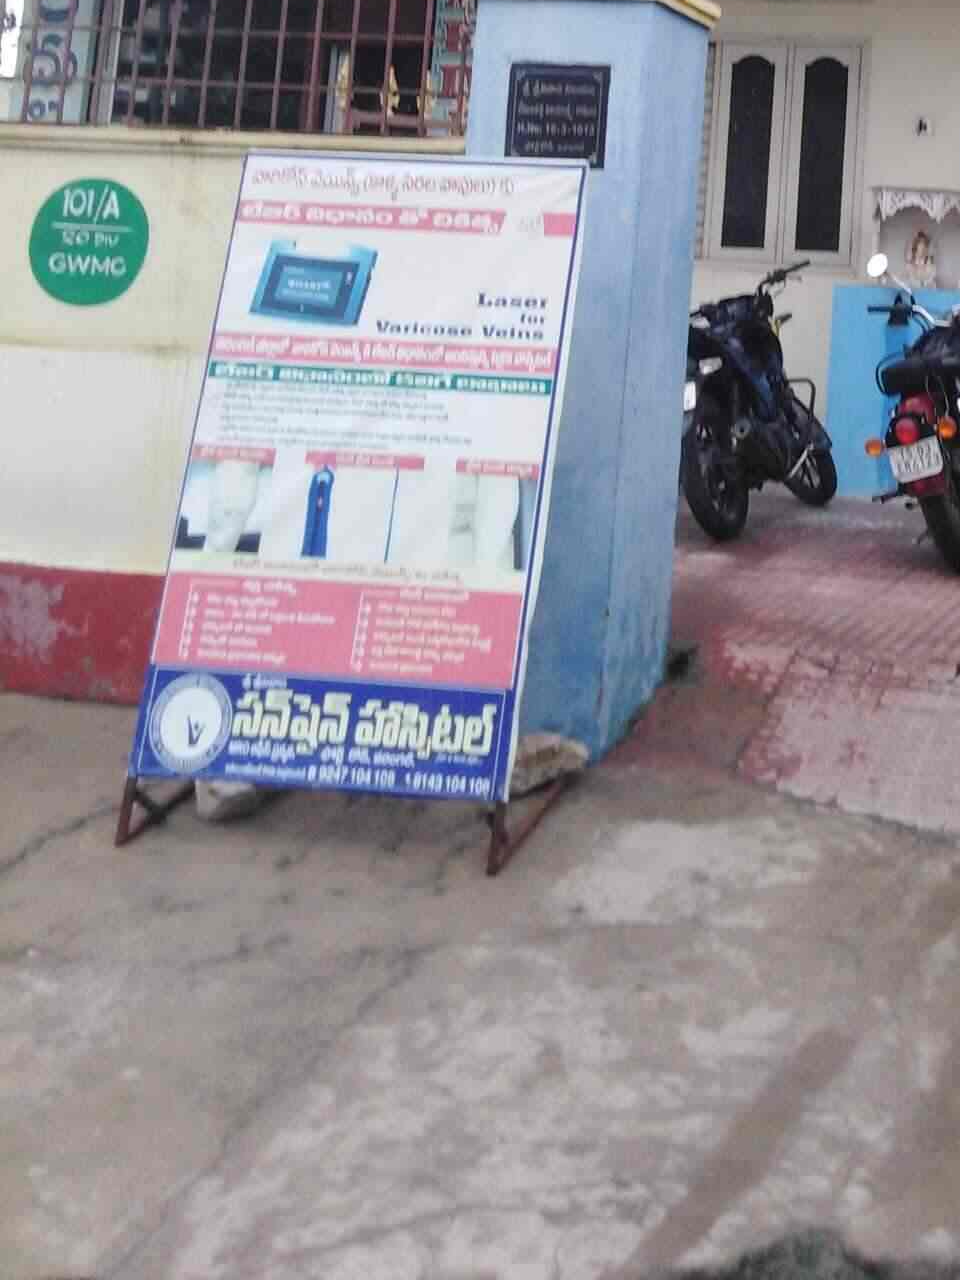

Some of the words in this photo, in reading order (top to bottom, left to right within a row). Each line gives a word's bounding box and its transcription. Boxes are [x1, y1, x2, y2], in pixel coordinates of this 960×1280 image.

[477, 293, 547, 309] Laser
[376, 320, 473, 337] Varicose
[482, 324, 544, 341] Veins
